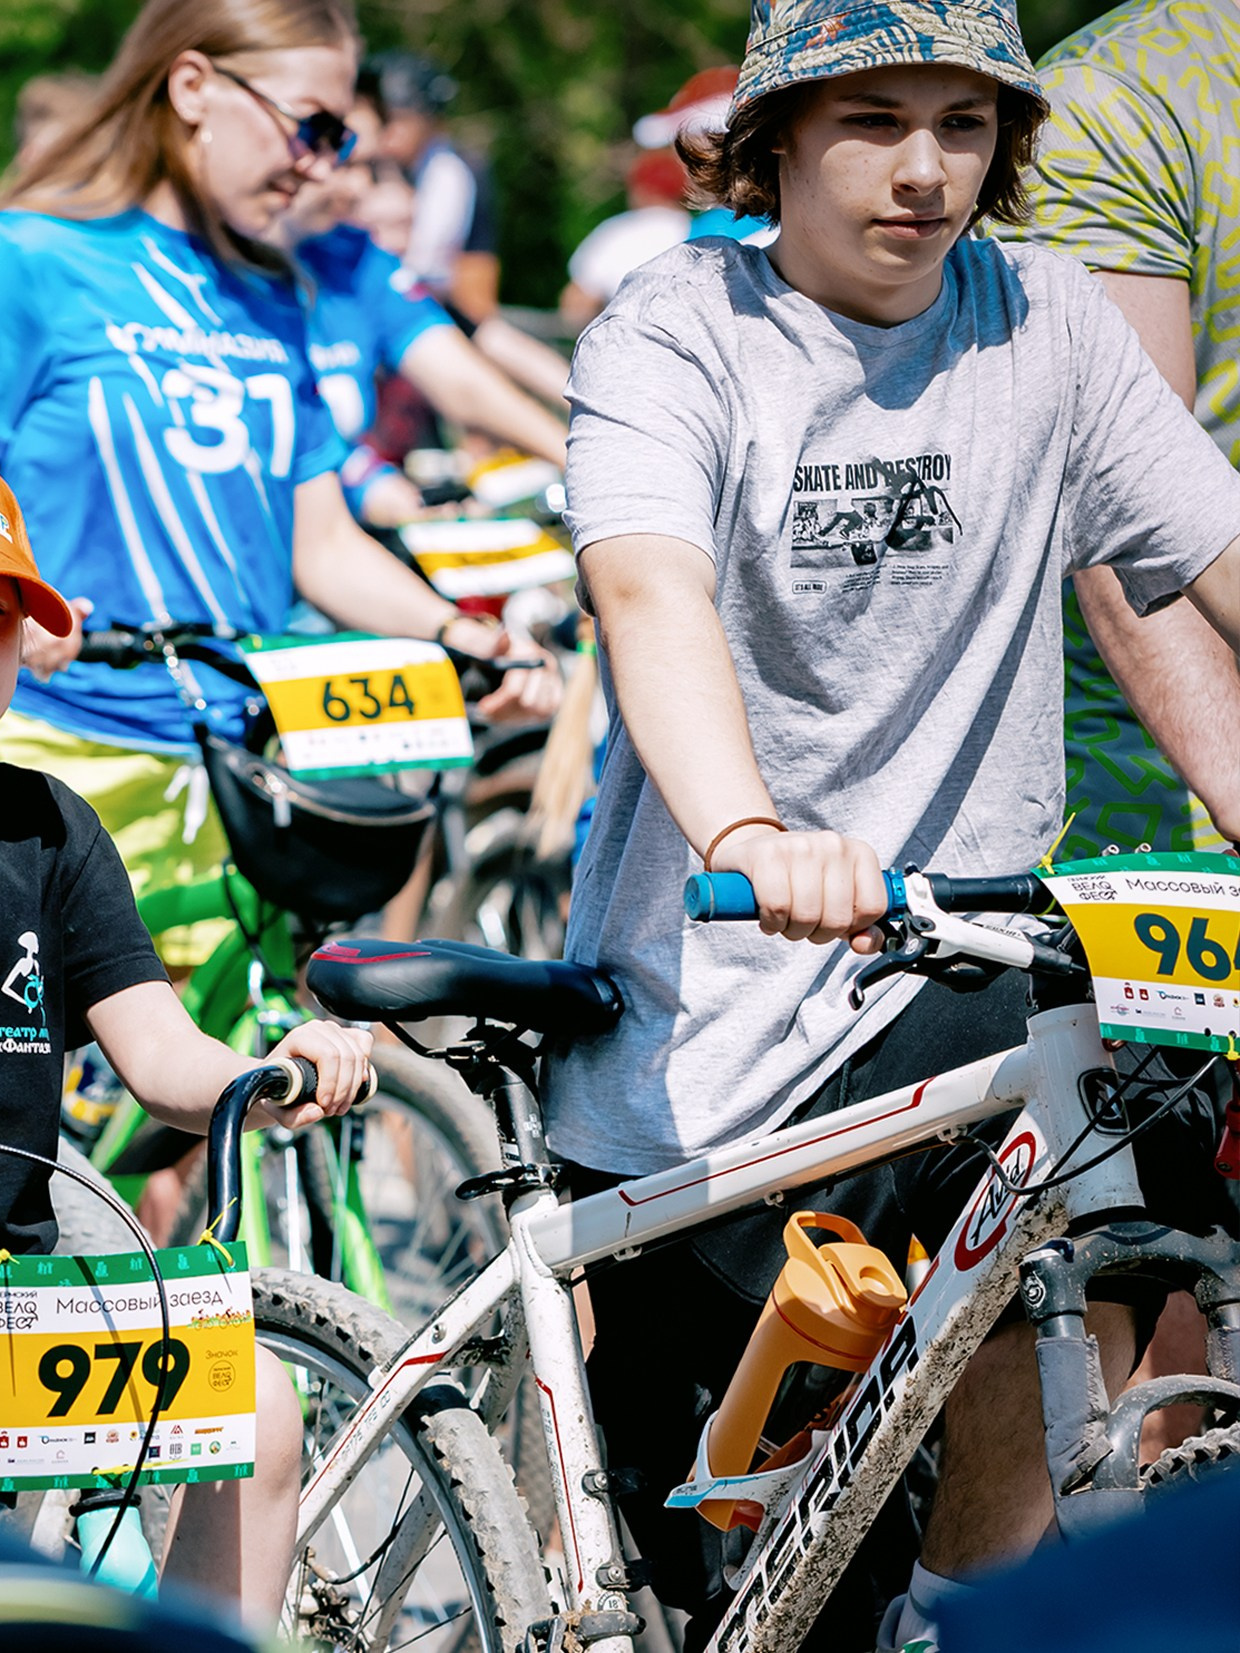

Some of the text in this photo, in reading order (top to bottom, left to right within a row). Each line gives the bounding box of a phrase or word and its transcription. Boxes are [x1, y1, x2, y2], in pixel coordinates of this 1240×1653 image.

[792, 465, 842, 493] SKATE
[845, 462, 878, 490] AND
[322, 673, 415, 722] 634
[1125, 878, 1227, 896] Массовый
[55, 1290, 224, 1315] Массовый заезд
[37, 1337, 191, 1418] 979
